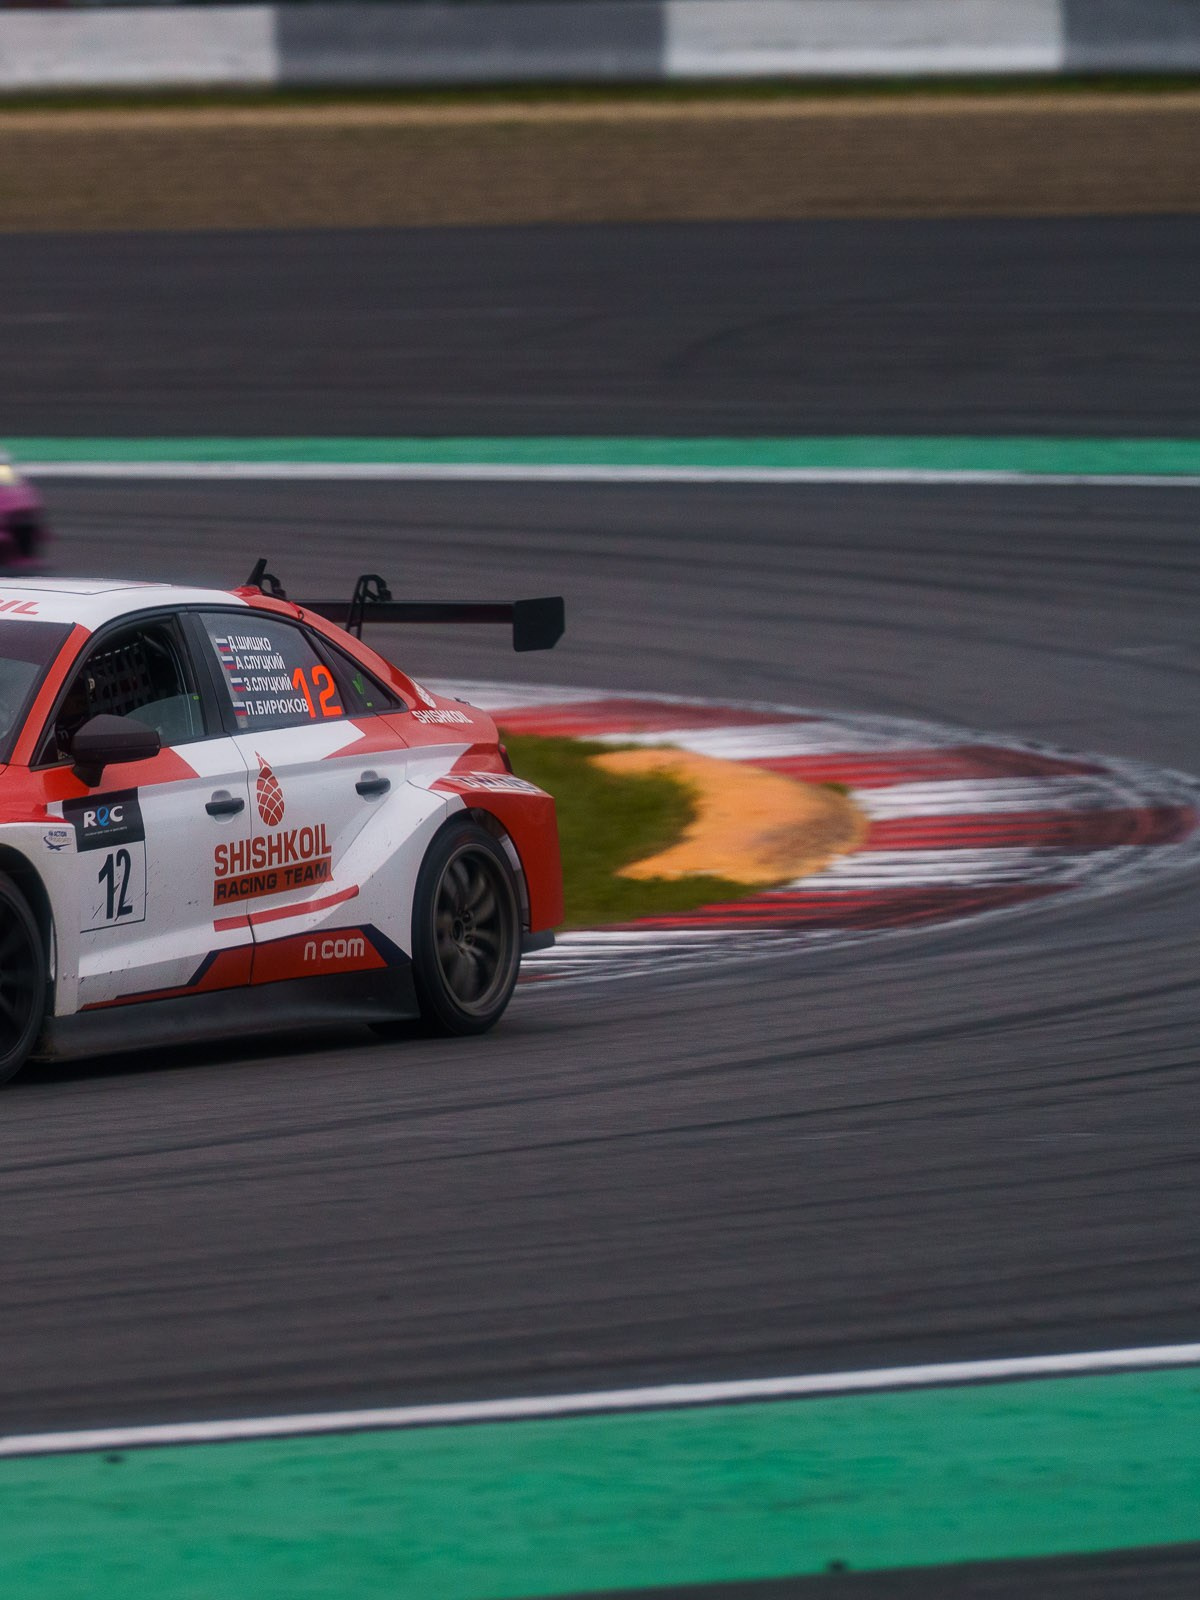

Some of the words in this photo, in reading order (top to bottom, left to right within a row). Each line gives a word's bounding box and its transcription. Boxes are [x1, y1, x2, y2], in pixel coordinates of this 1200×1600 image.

[227, 635, 272, 652] Д.ШИШКО
[235, 652, 286, 672] А.СЛУЦКИЙ
[243, 673, 293, 694] З.СЛУЦКИЙ
[292, 664, 343, 718] 12
[245, 698, 309, 716] П.БИРЮКОВ
[412, 710, 474, 725] SHISHKOIL
[214, 824, 332, 876] SHISHKOIL
[98, 849, 133, 920] 12
[216, 876, 278, 899] RACING
[285, 862, 328, 886] TEAM
